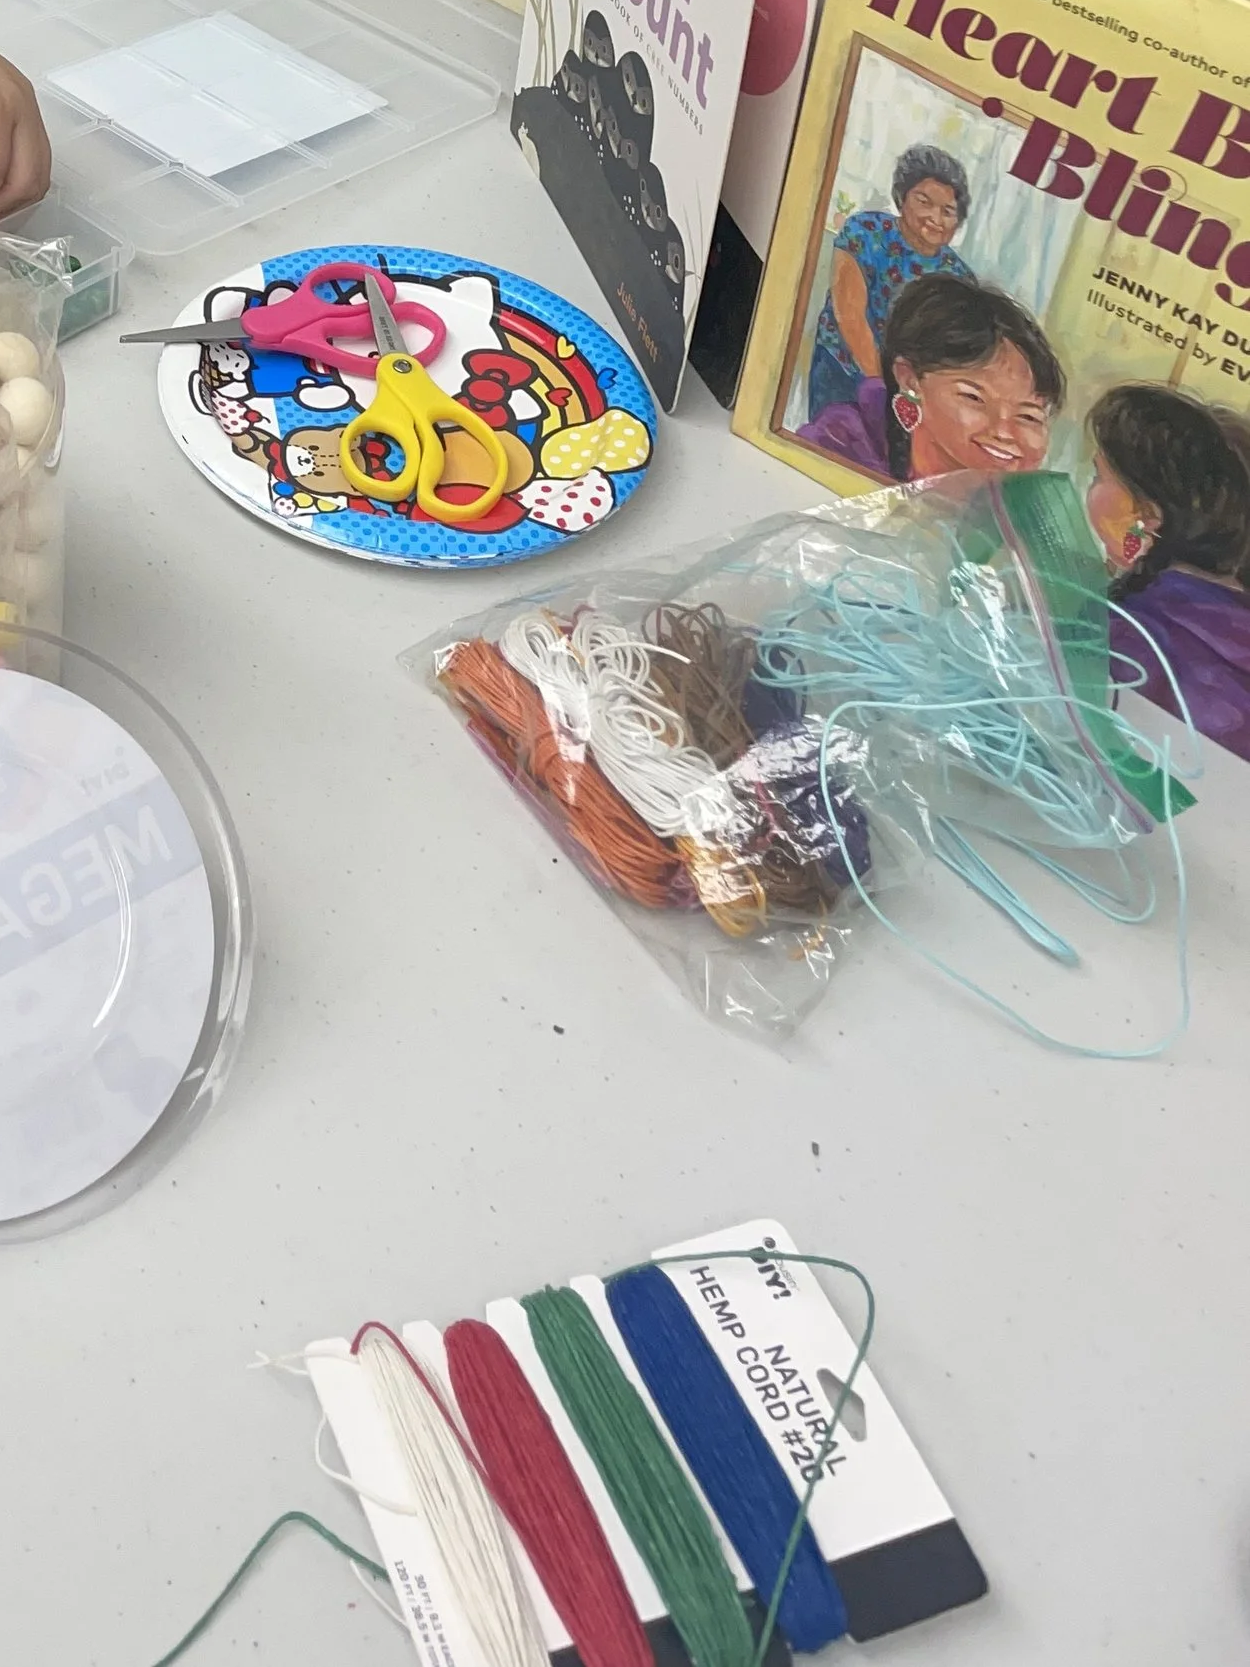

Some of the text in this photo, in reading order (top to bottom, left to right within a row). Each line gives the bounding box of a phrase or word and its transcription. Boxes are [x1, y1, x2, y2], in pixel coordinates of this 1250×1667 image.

[633, 25, 644, 43] OF
[668, 75, 704, 136] NUMBERS
[1142, 36, 1229, 78] co-author
[1087, 289, 1188, 350] Illustrated
[1192, 343, 1217, 366] by
[1092, 267, 1170, 309] JENNY
[1172, 303, 1220, 335] KAY
[689, 1265, 746, 1339] HEMP
[736, 1346, 790, 1421] CORD
[764, 1345, 847, 1476] NATURAL
[394, 1560, 410, 1581] 120
